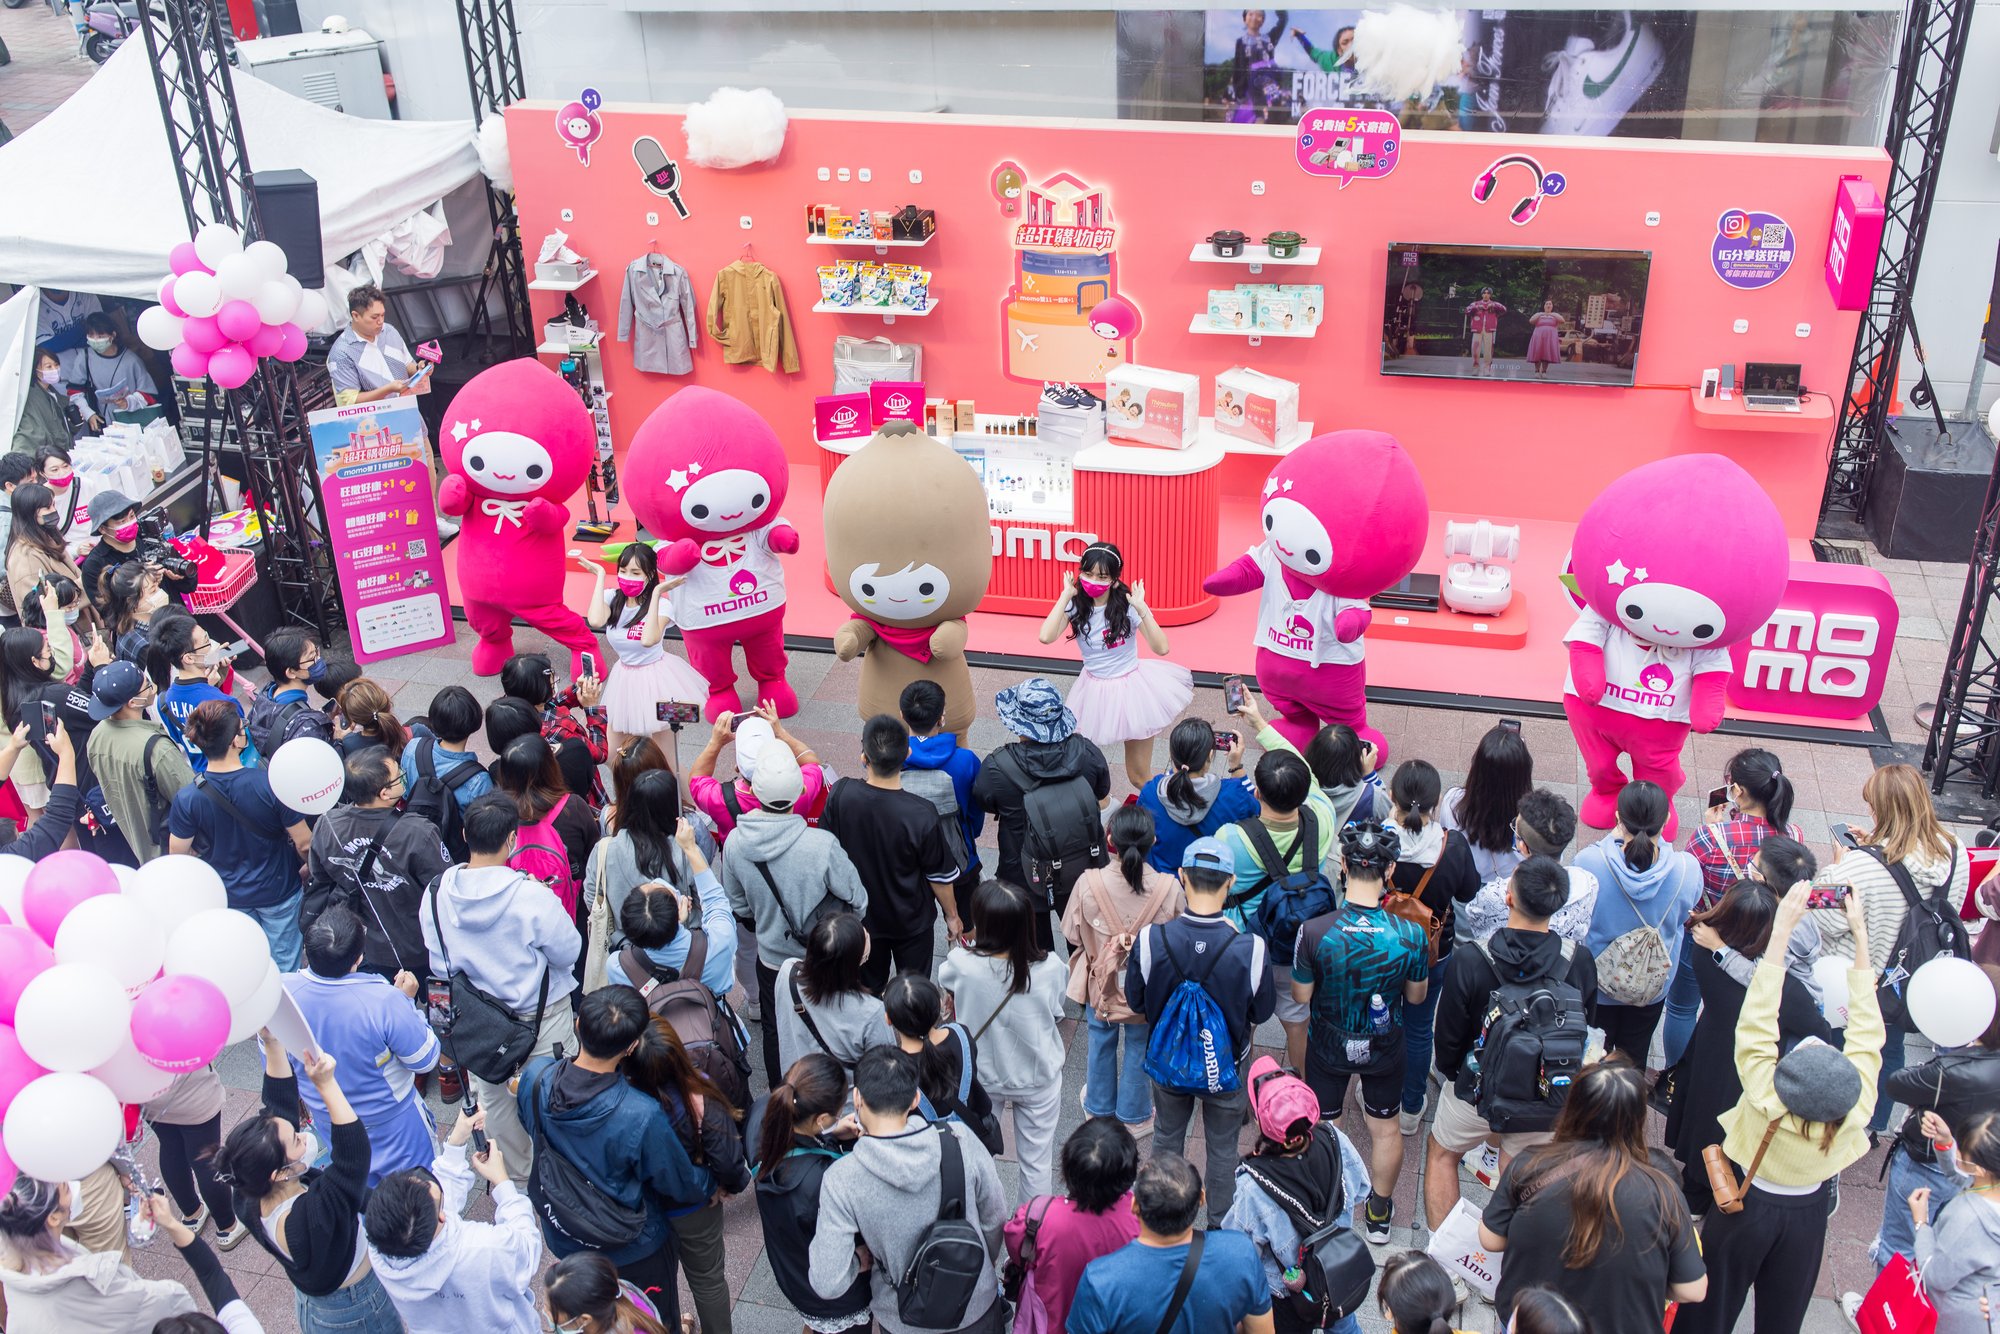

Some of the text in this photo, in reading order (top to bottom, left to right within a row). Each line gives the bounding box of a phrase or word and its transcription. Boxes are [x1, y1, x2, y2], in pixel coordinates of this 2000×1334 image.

[585, 94, 598, 105] +1
[1015, 225, 1115, 250] 超狂購物節
[1718, 249, 1792, 262] IG分享送好禮
[338, 405, 376, 417] momo
[704, 590, 768, 616] momo
[301, 776, 342, 804] momo
[1341, 925, 1385, 933] MERIDA
[1455, 1253, 1493, 1283] Amo
